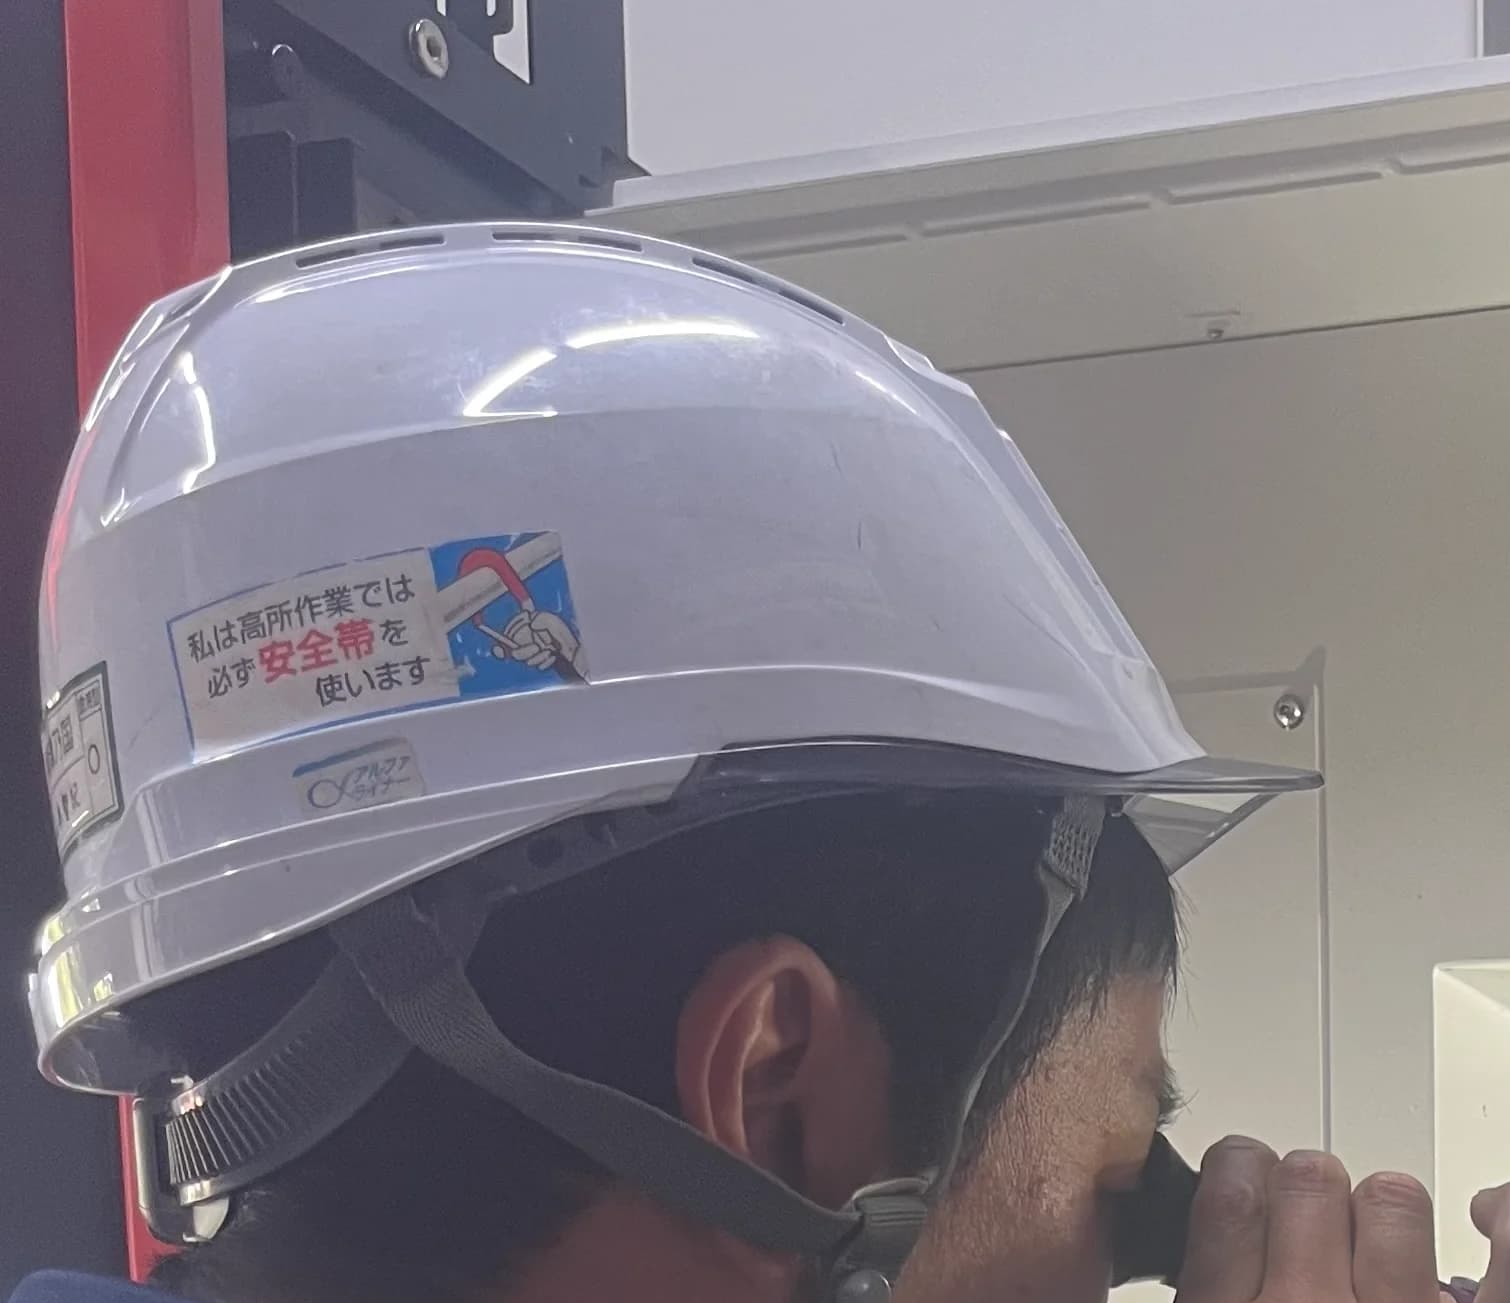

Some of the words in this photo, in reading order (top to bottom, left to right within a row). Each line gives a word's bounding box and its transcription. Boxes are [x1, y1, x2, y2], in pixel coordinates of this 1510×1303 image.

[187, 574, 415, 663] 私は高所作業では
[315, 655, 431, 706] 使います
